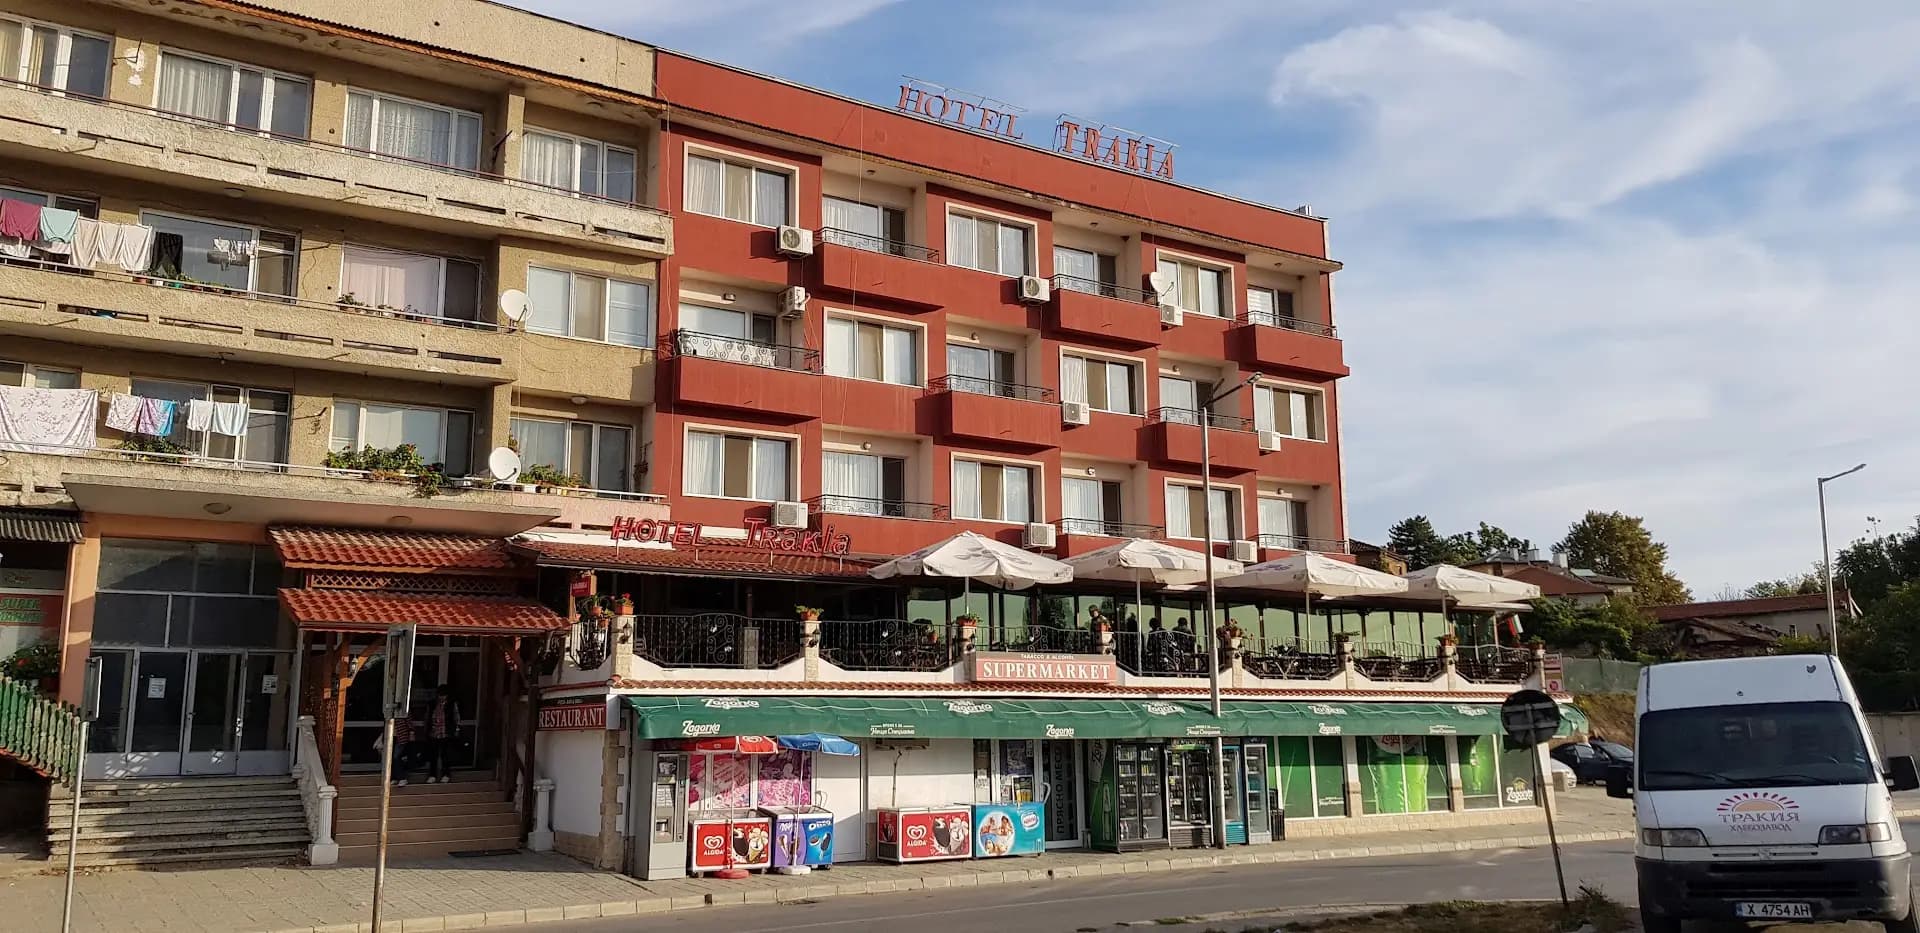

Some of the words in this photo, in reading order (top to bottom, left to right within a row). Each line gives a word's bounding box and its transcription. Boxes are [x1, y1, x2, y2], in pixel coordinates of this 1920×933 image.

[896, 85, 1024, 140] HOTEL
[1061, 120, 1174, 179] TRAKIA
[610, 515, 706, 547] HOTEL
[983, 661, 1111, 680] SUPERMARKET
[538, 706, 605, 728] RESTAURANT
[682, 720, 721, 737] Zagorka
[1054, 783, 1065, 834] ПРЯСНО
[1718, 812, 1800, 823] ТРАКИЯ
[1729, 823, 1793, 832] ХЛЕБОЗАВОД
[907, 839, 927, 847] ALGIDA
[1761, 905, 1791, 916] 4754
